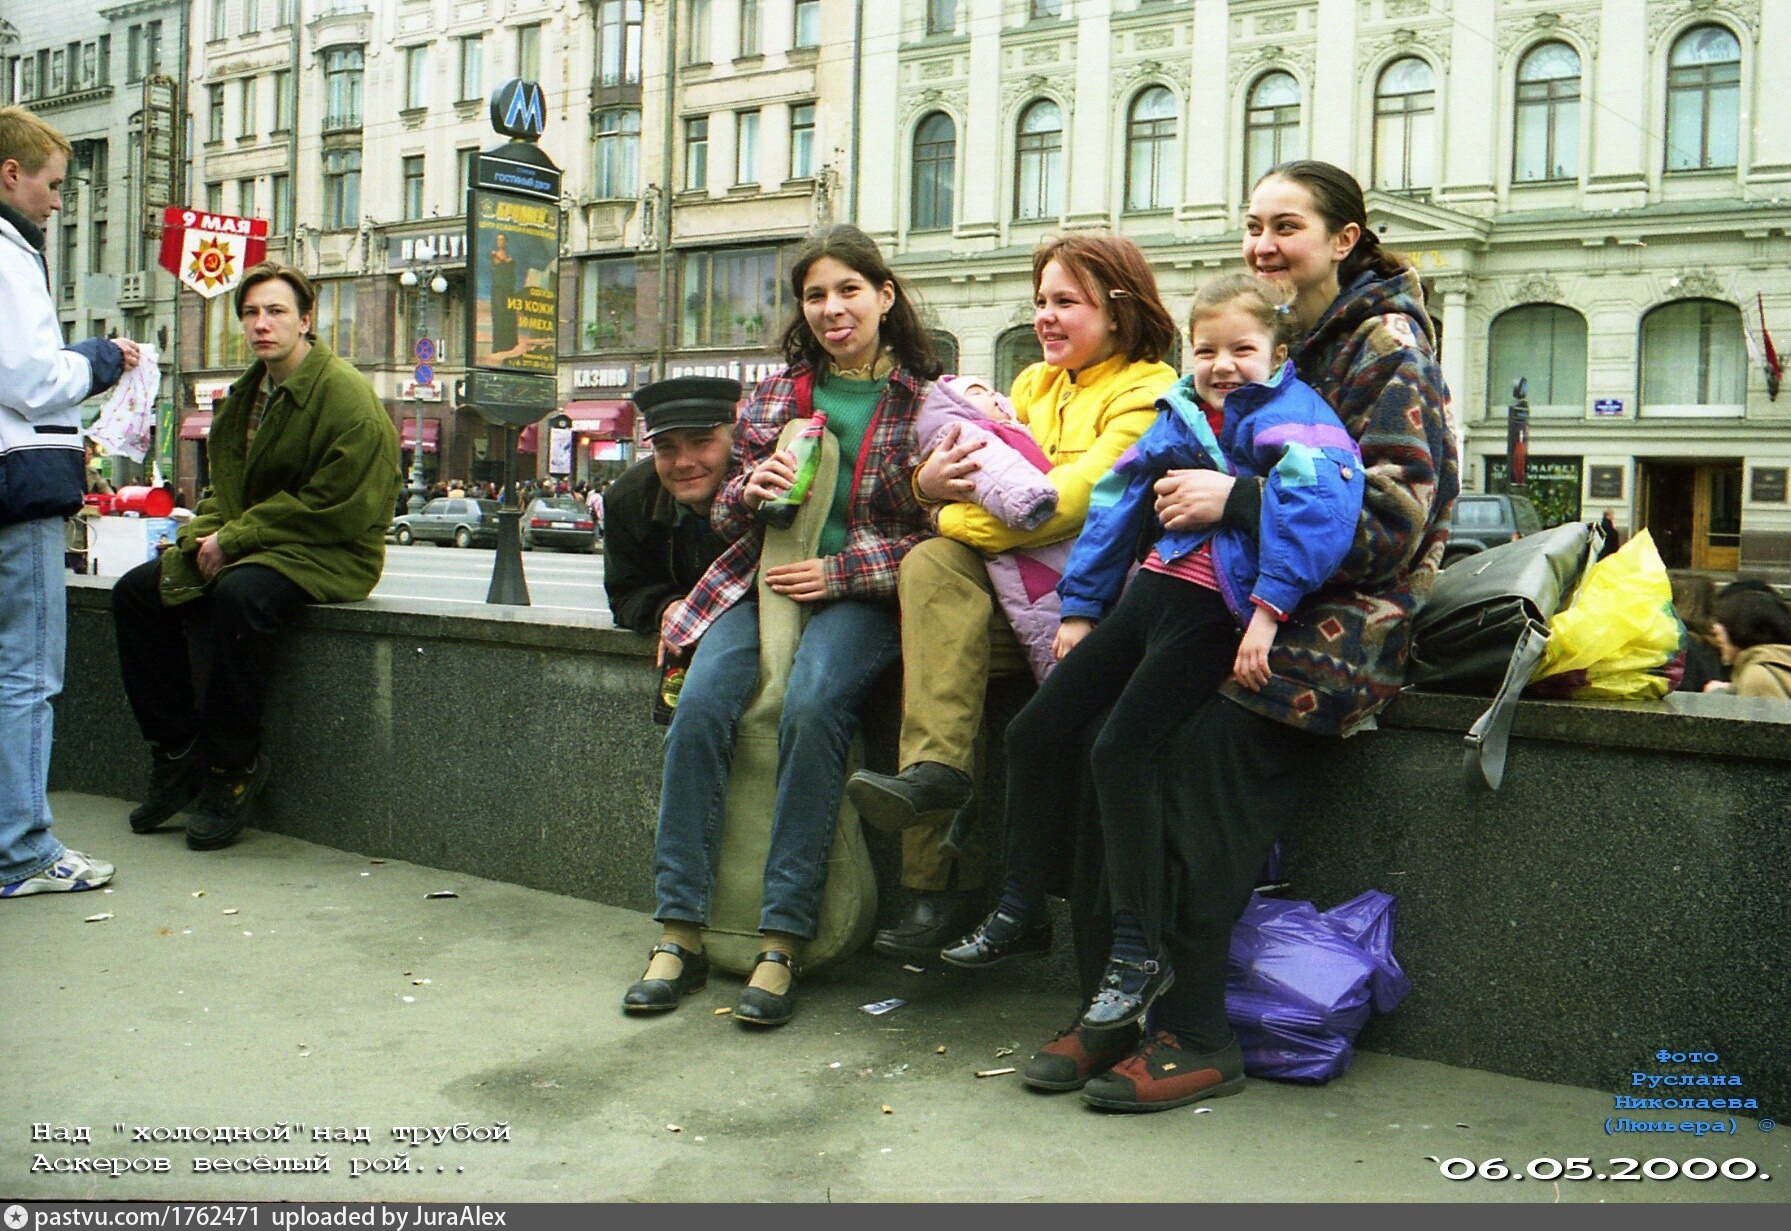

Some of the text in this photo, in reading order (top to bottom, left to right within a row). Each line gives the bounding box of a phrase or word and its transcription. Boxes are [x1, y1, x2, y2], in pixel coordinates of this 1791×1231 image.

[182, 211, 251, 234] 9 МАЯ
[402, 234, 468, 260] HOLLY
[507, 297, 523, 310] ИЗ
[573, 368, 629, 388] КАЗИНО
